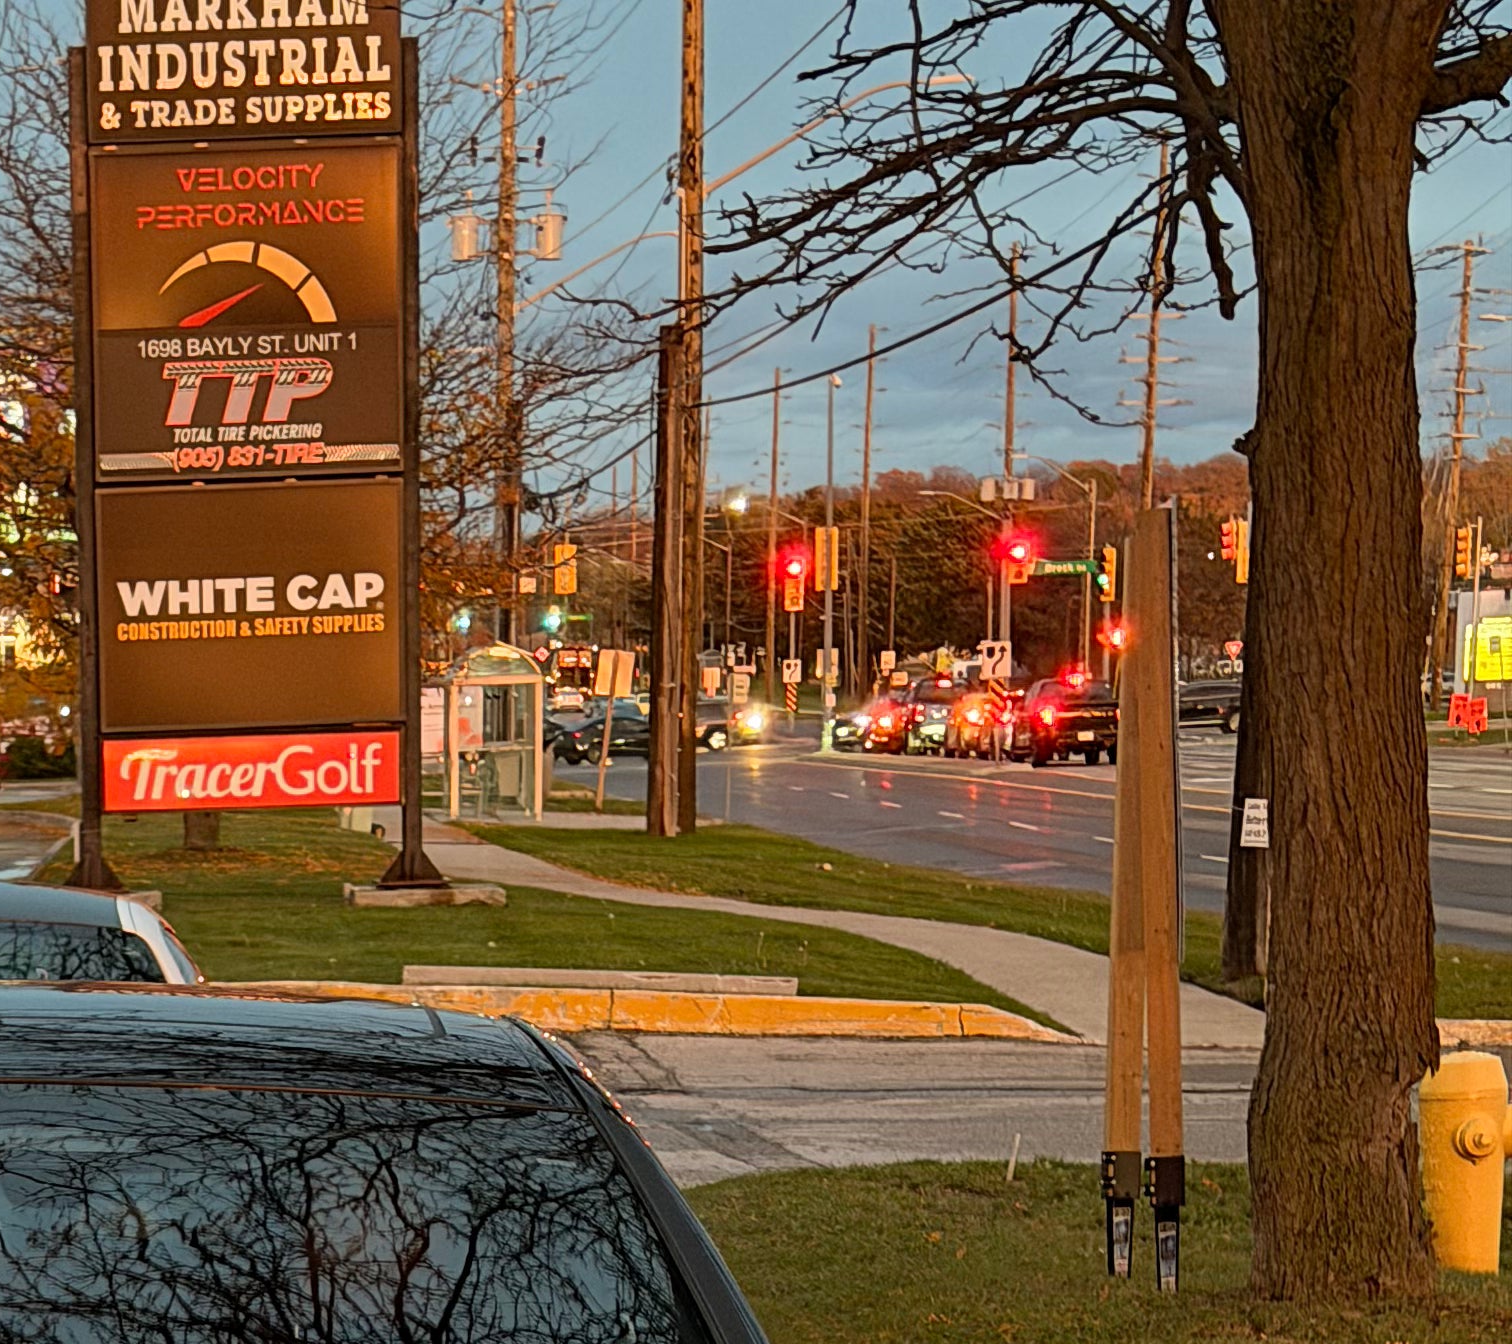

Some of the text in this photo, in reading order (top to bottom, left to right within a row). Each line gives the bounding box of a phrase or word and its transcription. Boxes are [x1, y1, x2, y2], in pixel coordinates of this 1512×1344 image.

[117, 0, 369, 33] MARKHAM
[97, 35, 391, 92] INDUSTRIAL
[100, 91, 392, 130] & TRADE SUPPLIES
[176, 163, 324, 192] VELOCITY
[136, 198, 365, 230] PERFORMANCE
[138, 332, 358, 359] 1698 BAYLY ST. UNIT 1
[161, 357, 335, 426] TTP
[173, 423, 323, 443] TOTAL TIRE PICKERING
[173, 445, 224, 473] (905)
[116, 572, 385, 617] WHITE CAP
[117, 613, 385, 642] CONSTRUCTION & SAFETY SUPPLIES
[119, 741, 384, 802] TracerGolf
